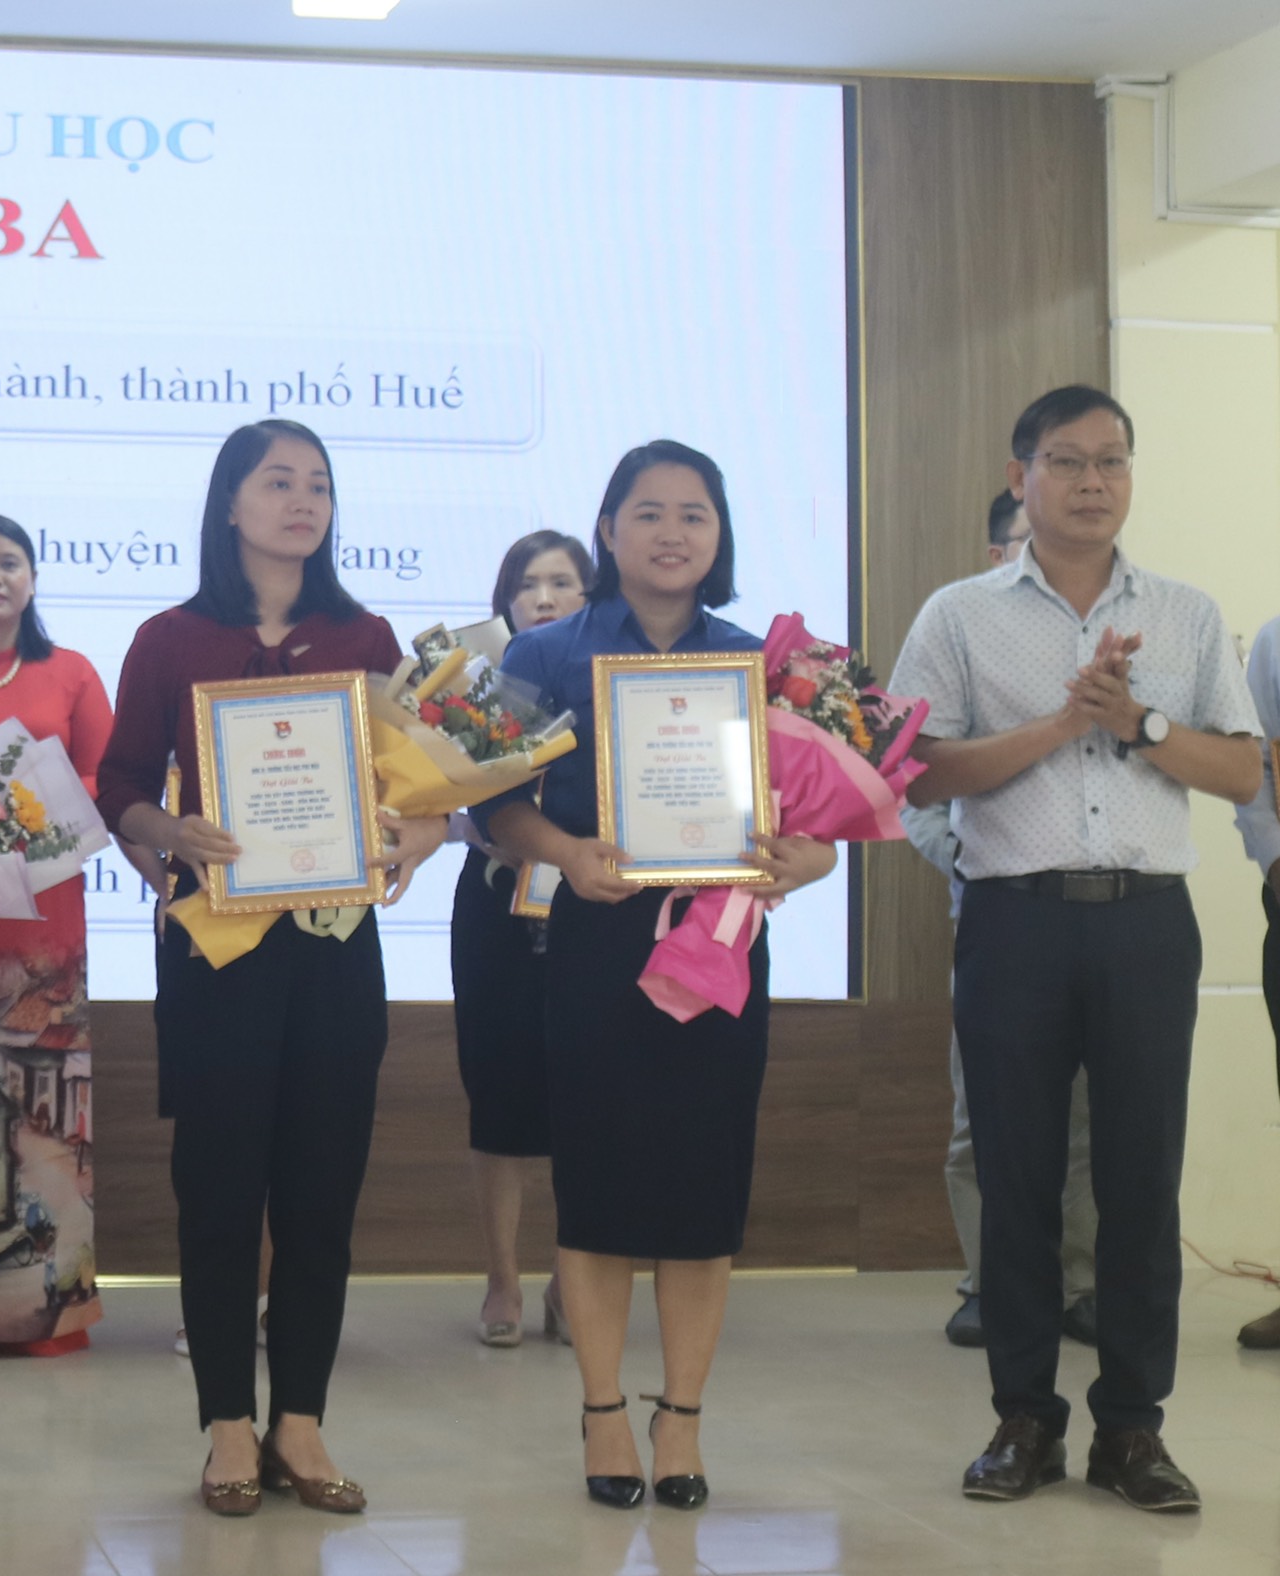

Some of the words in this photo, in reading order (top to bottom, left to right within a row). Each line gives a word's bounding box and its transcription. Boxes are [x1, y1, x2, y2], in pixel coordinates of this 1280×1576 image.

[49, 113, 216, 173] HỌC
[120, 365, 250, 404] thành
[267, 363, 353, 415] phố
[371, 365, 465, 410] Huế
[40, 528, 179, 574] huyện
[336, 535, 424, 581] ang
